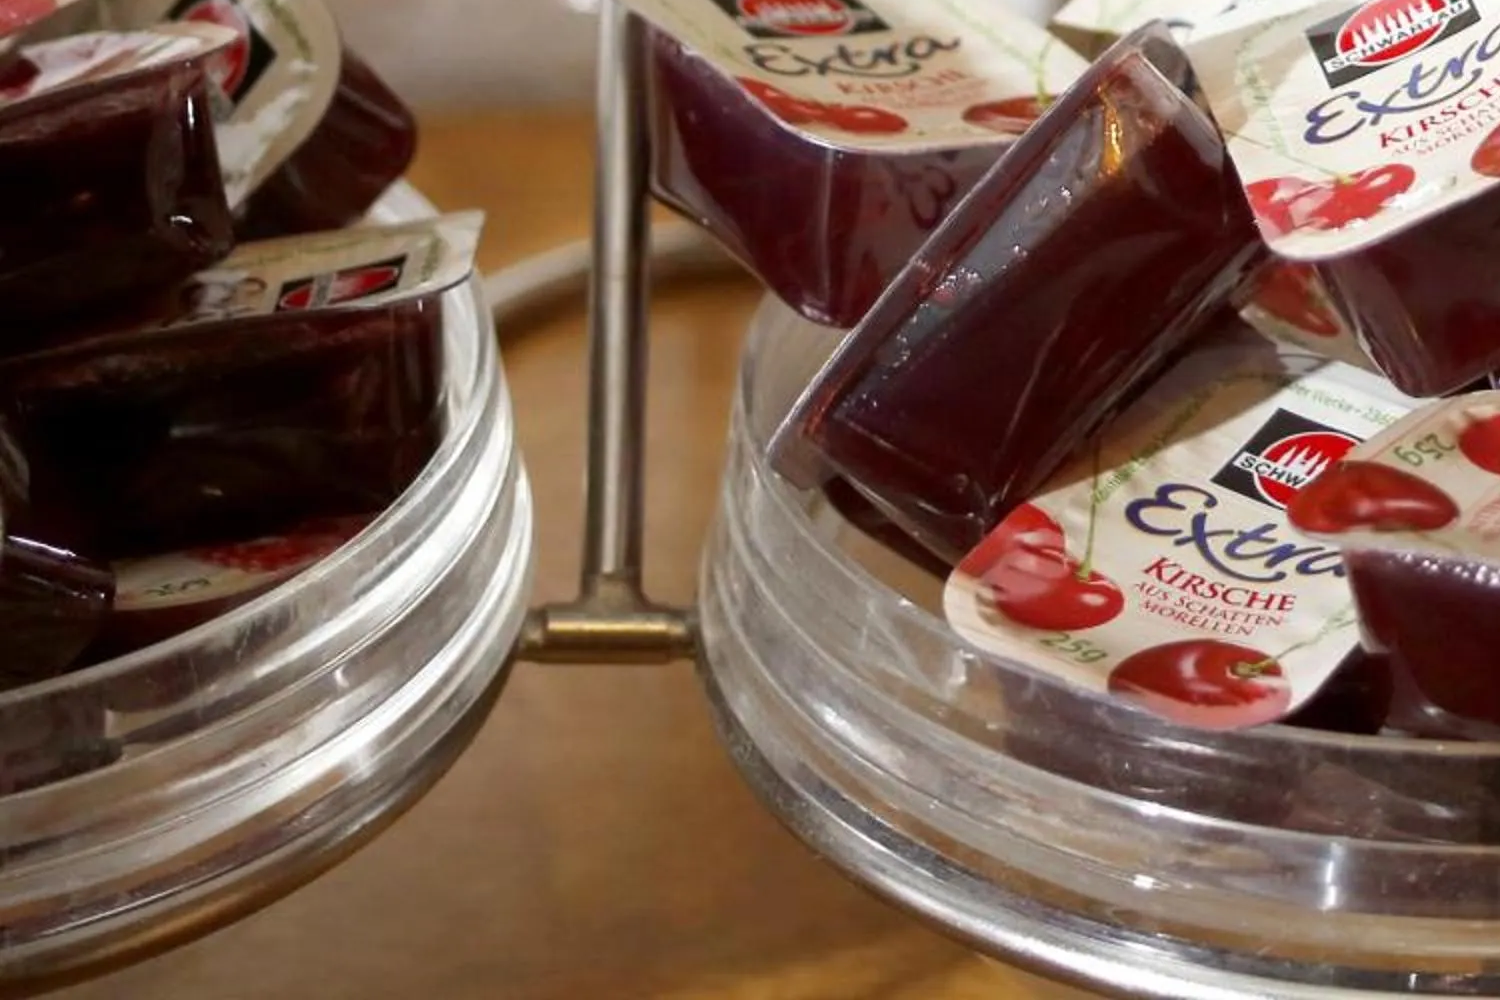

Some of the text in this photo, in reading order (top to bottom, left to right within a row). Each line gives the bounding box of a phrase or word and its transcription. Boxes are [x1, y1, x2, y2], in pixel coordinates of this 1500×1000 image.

[1330, 2, 1466, 70] SCHWARTAU
[743, 35, 961, 78] Extra
[1394, 432, 1456, 467] 25g
[1144, 554, 1297, 613] KIRSCHE
[1140, 600, 1255, 637] MORELLEN
[1040, 632, 1109, 664] 25g
